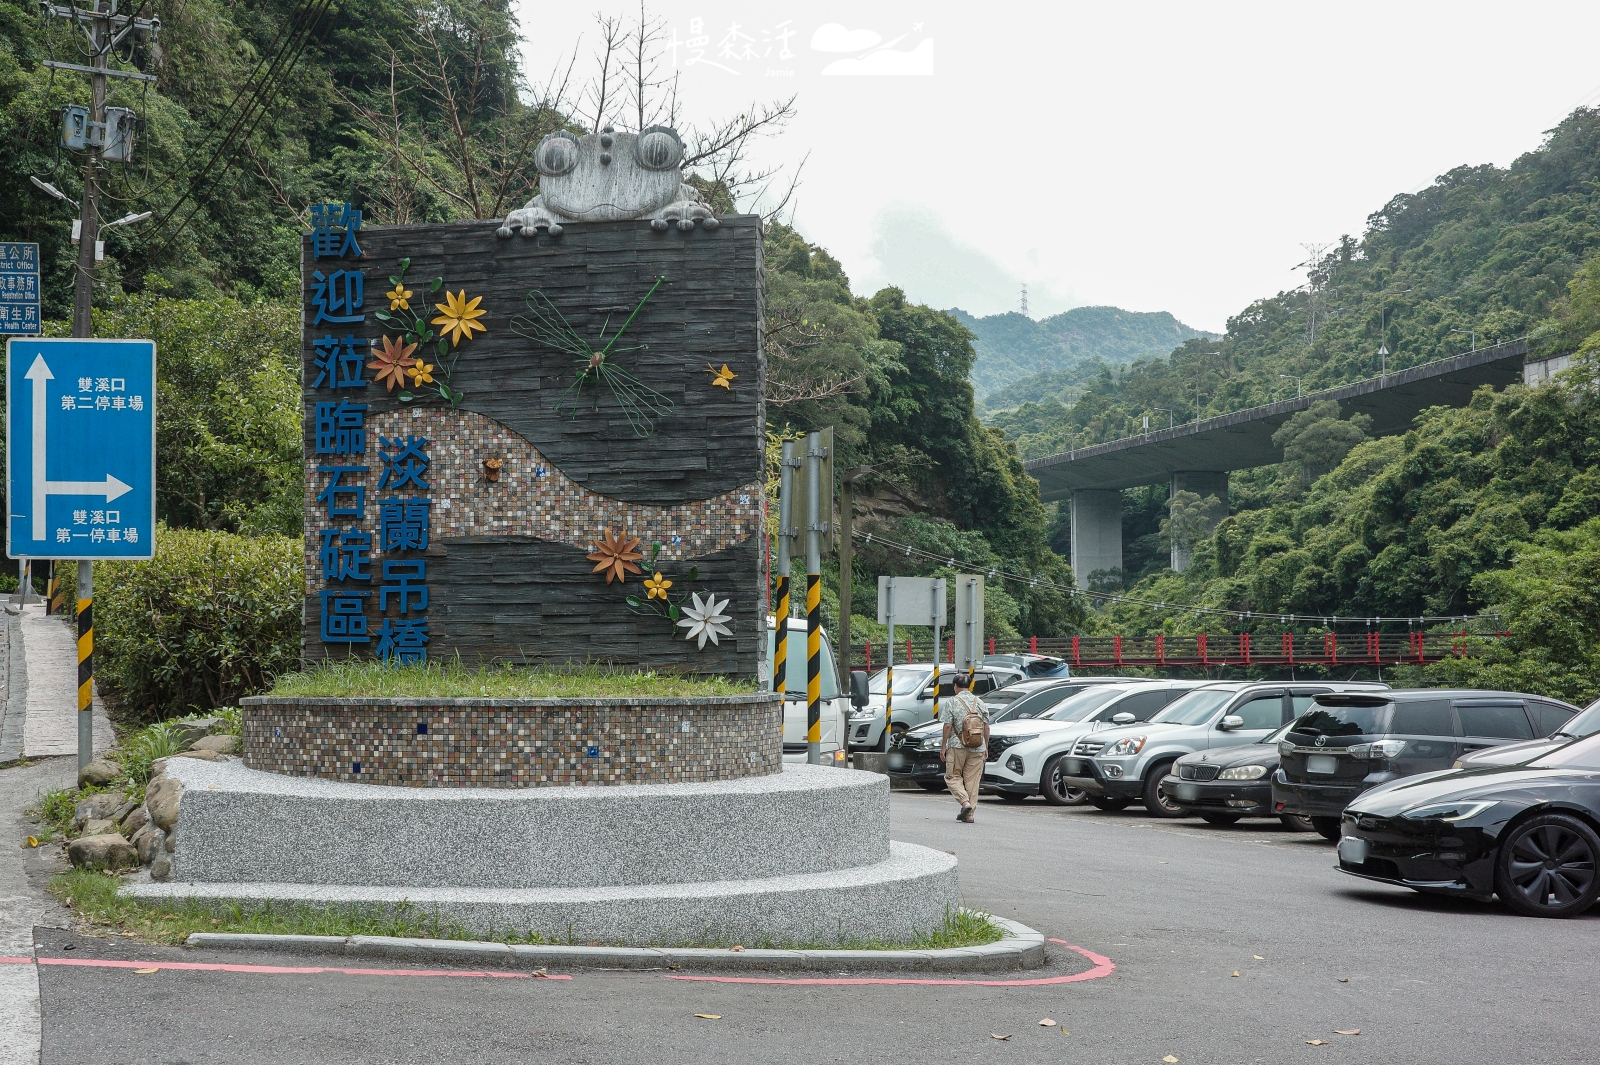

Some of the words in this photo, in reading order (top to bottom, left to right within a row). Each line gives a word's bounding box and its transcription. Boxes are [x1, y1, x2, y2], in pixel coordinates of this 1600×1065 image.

[17, 262, 34, 270] Office
[4, 322, 20, 330] Health
[22, 322, 37, 330] Center
[77, 377, 126, 392] 雙溪口
[61, 395, 144, 411] 第二停車場
[310, 202, 372, 644] 歡迎蒞臨石碇區
[72, 509, 120, 525] 雙溪口
[56, 527, 139, 543] 第一停車場
[374, 434, 430, 670] 淡蘭吊橋
